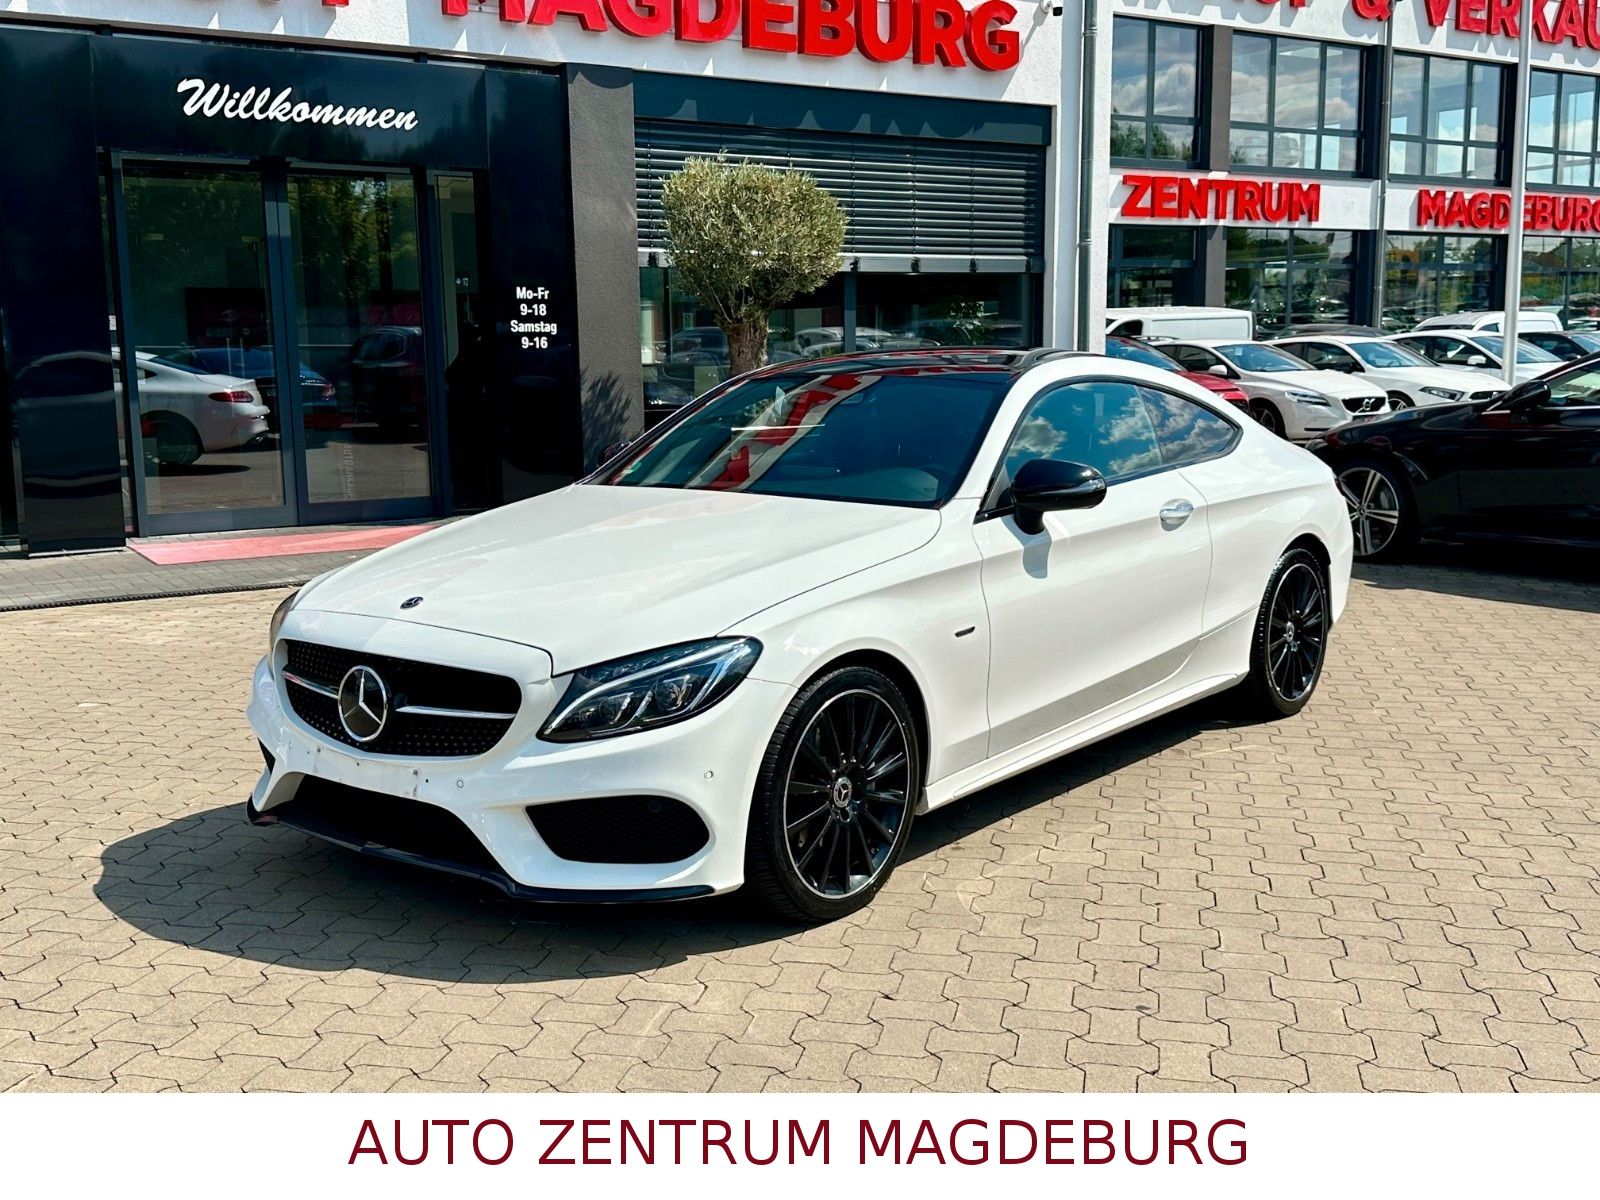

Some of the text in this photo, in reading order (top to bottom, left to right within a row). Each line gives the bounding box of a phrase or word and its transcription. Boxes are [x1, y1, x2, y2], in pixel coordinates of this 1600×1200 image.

[442, 0, 1020, 71] GDEBURG
[177, 78, 418, 131] Willkommen
[1121, 174, 1321, 223] ZENTRUM
[515, 286, 550, 300] Mo-Fr
[519, 303, 547, 316] 9-18
[510, 319, 558, 336] Samstag
[521, 336, 549, 349] 9-16
